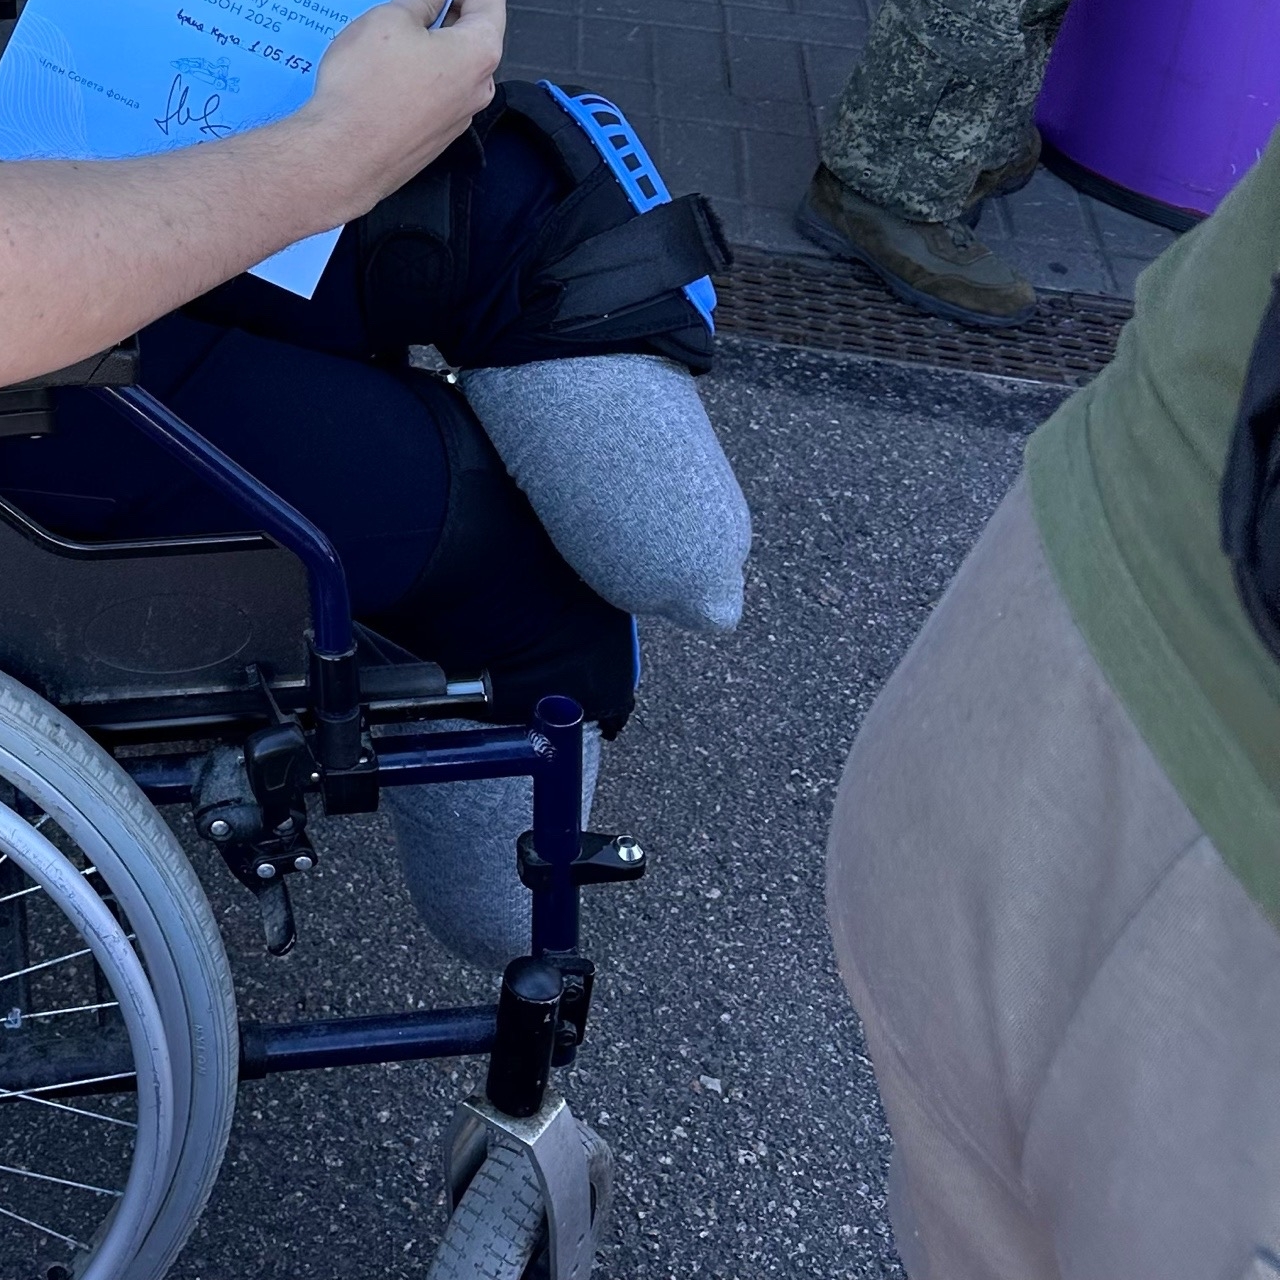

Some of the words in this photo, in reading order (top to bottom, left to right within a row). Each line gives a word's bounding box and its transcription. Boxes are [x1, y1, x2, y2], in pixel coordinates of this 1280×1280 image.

[245, 8, 282, 34] 2026
[68, 70, 104, 93] Совета
[106, 88, 140, 110] фонда
